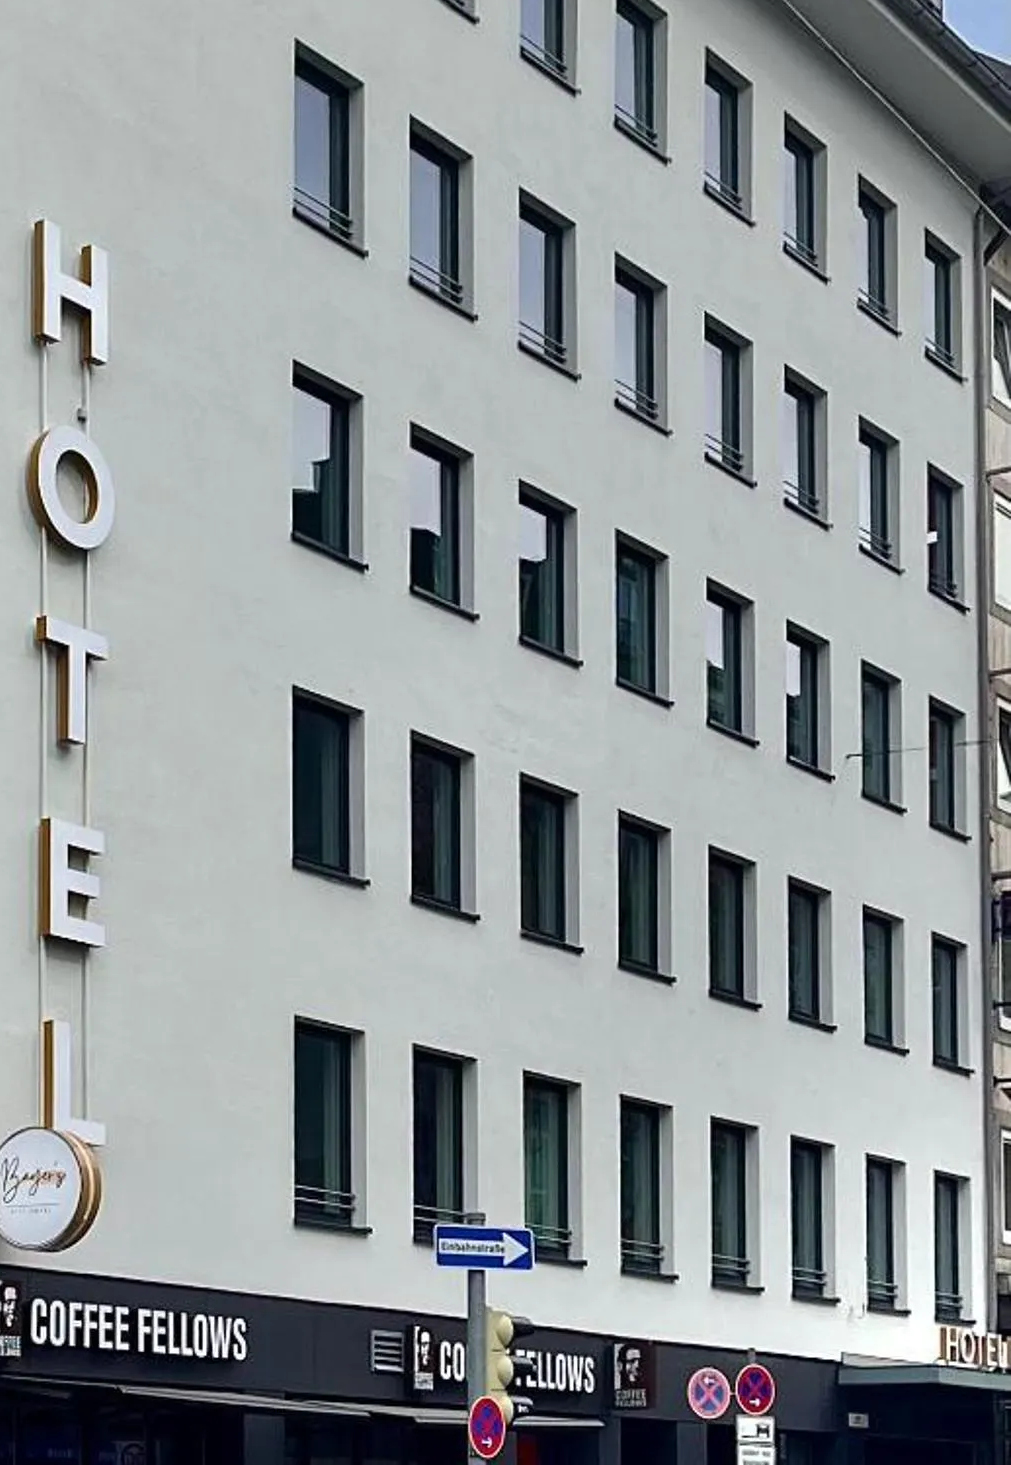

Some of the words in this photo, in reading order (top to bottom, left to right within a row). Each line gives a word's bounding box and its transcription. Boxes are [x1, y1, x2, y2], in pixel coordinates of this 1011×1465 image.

[26, 218, 115, 1147] HOTEL
[440, 1240, 505, 1254] Einbahnstraße
[30, 1297, 130, 1351] COFFEE
[137, 1308, 248, 1361] FELLOWS
